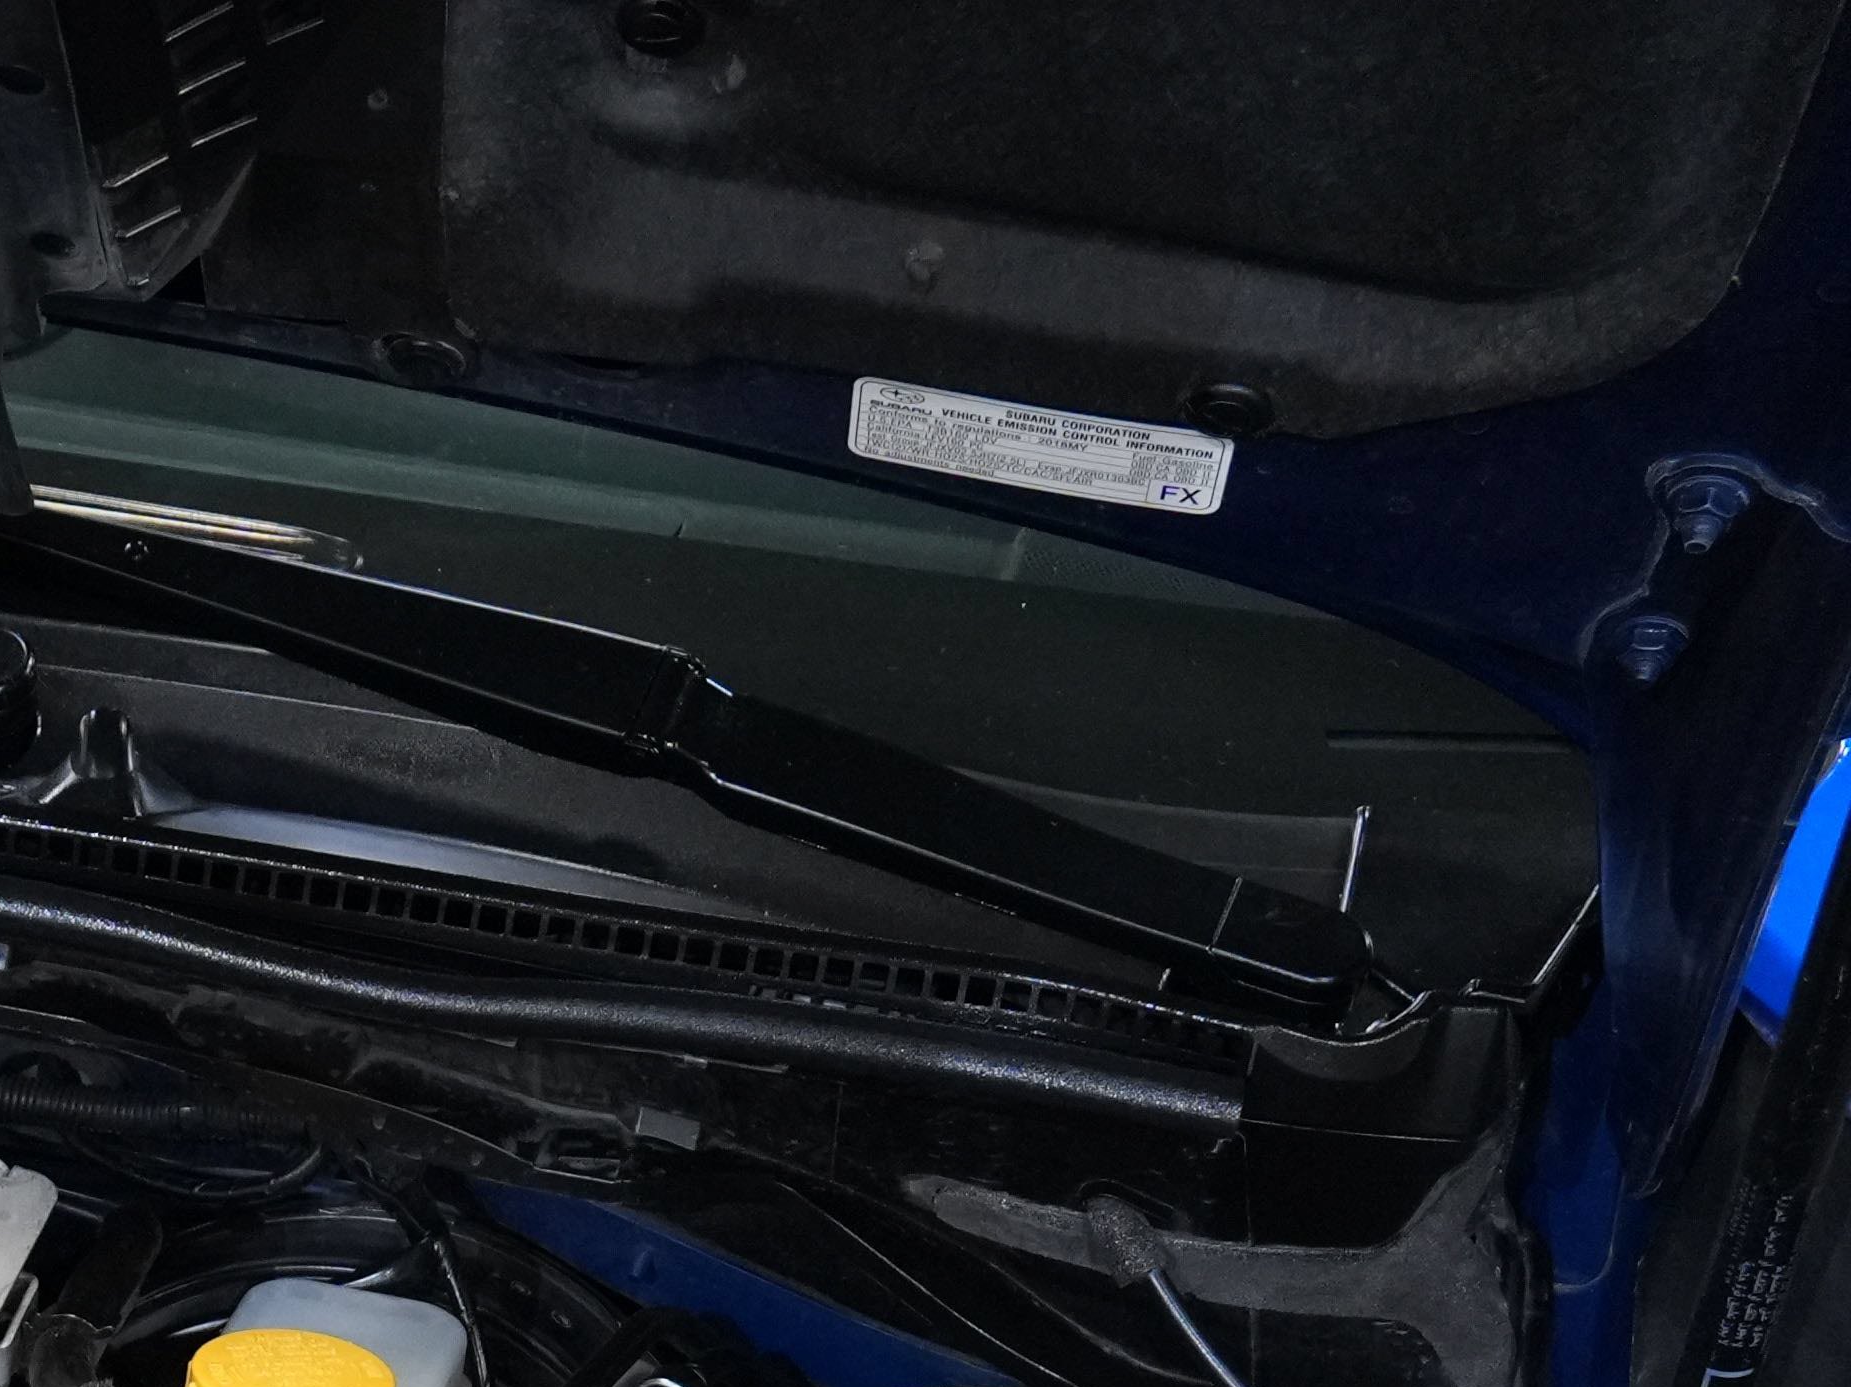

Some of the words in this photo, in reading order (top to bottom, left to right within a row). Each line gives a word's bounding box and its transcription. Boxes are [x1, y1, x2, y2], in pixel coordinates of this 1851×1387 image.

[870, 398, 932, 416] SUBARU
[942, 408, 991, 425] VEHICLE
[997, 419, 1057, 436] EMISSION
[1063, 430, 1120, 447] CONTROL
[1126, 440, 1214, 460] INFORMATION
[1005, 409, 1056, 426] SUBARU
[1062, 419, 1151, 441] CORPORATION
[1160, 484, 1202, 506] FX
